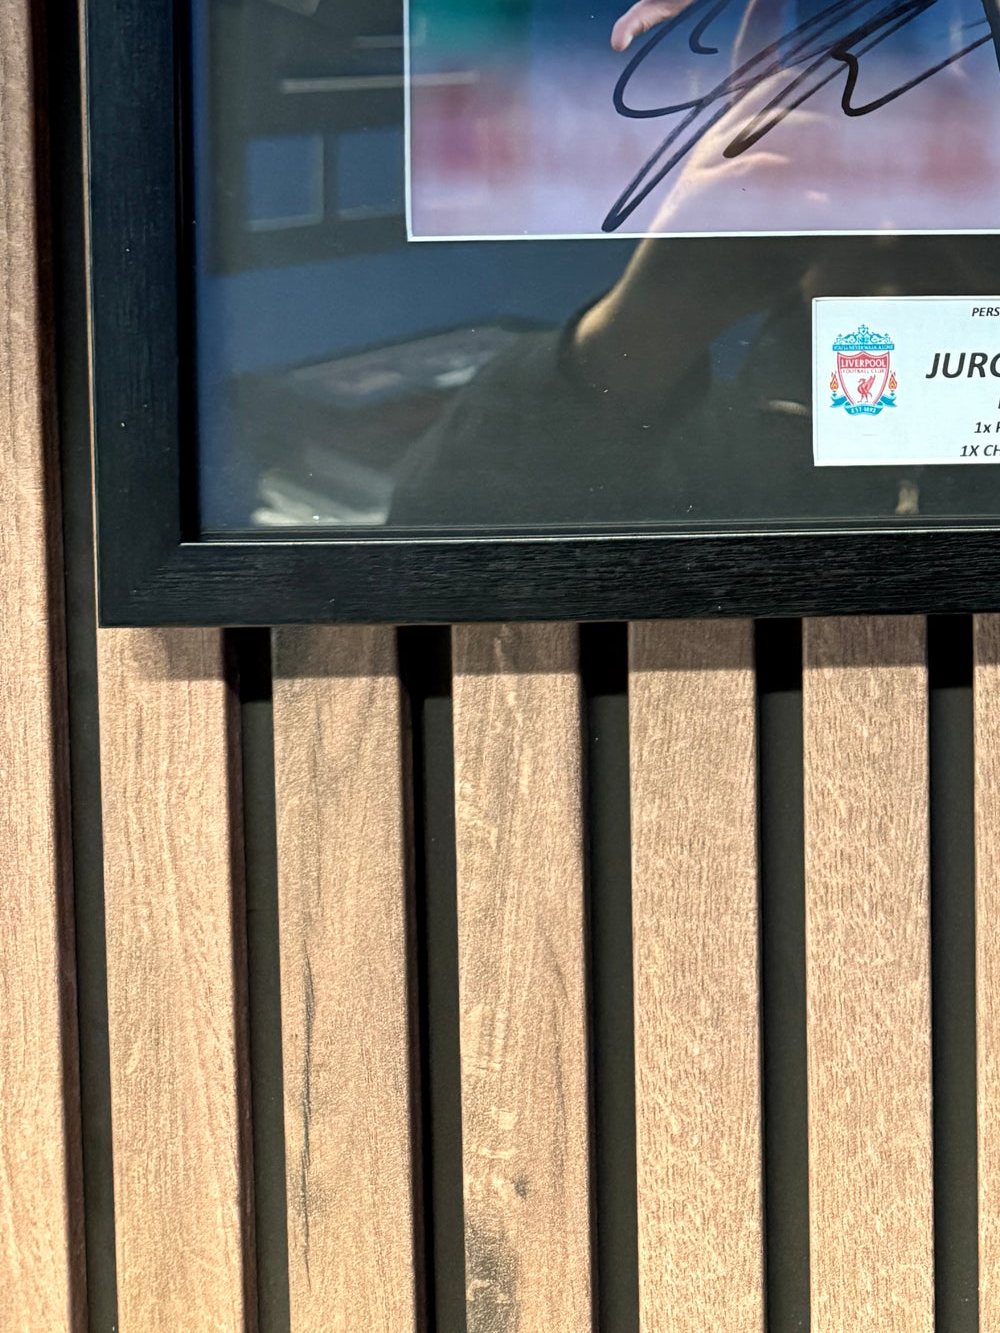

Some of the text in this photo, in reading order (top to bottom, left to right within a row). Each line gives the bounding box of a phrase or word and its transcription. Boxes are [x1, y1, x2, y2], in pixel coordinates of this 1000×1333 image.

[841, 358, 886, 368] LIVERPOOL
[974, 421, 991, 434] 1x
[960, 444, 980, 458] 1X
